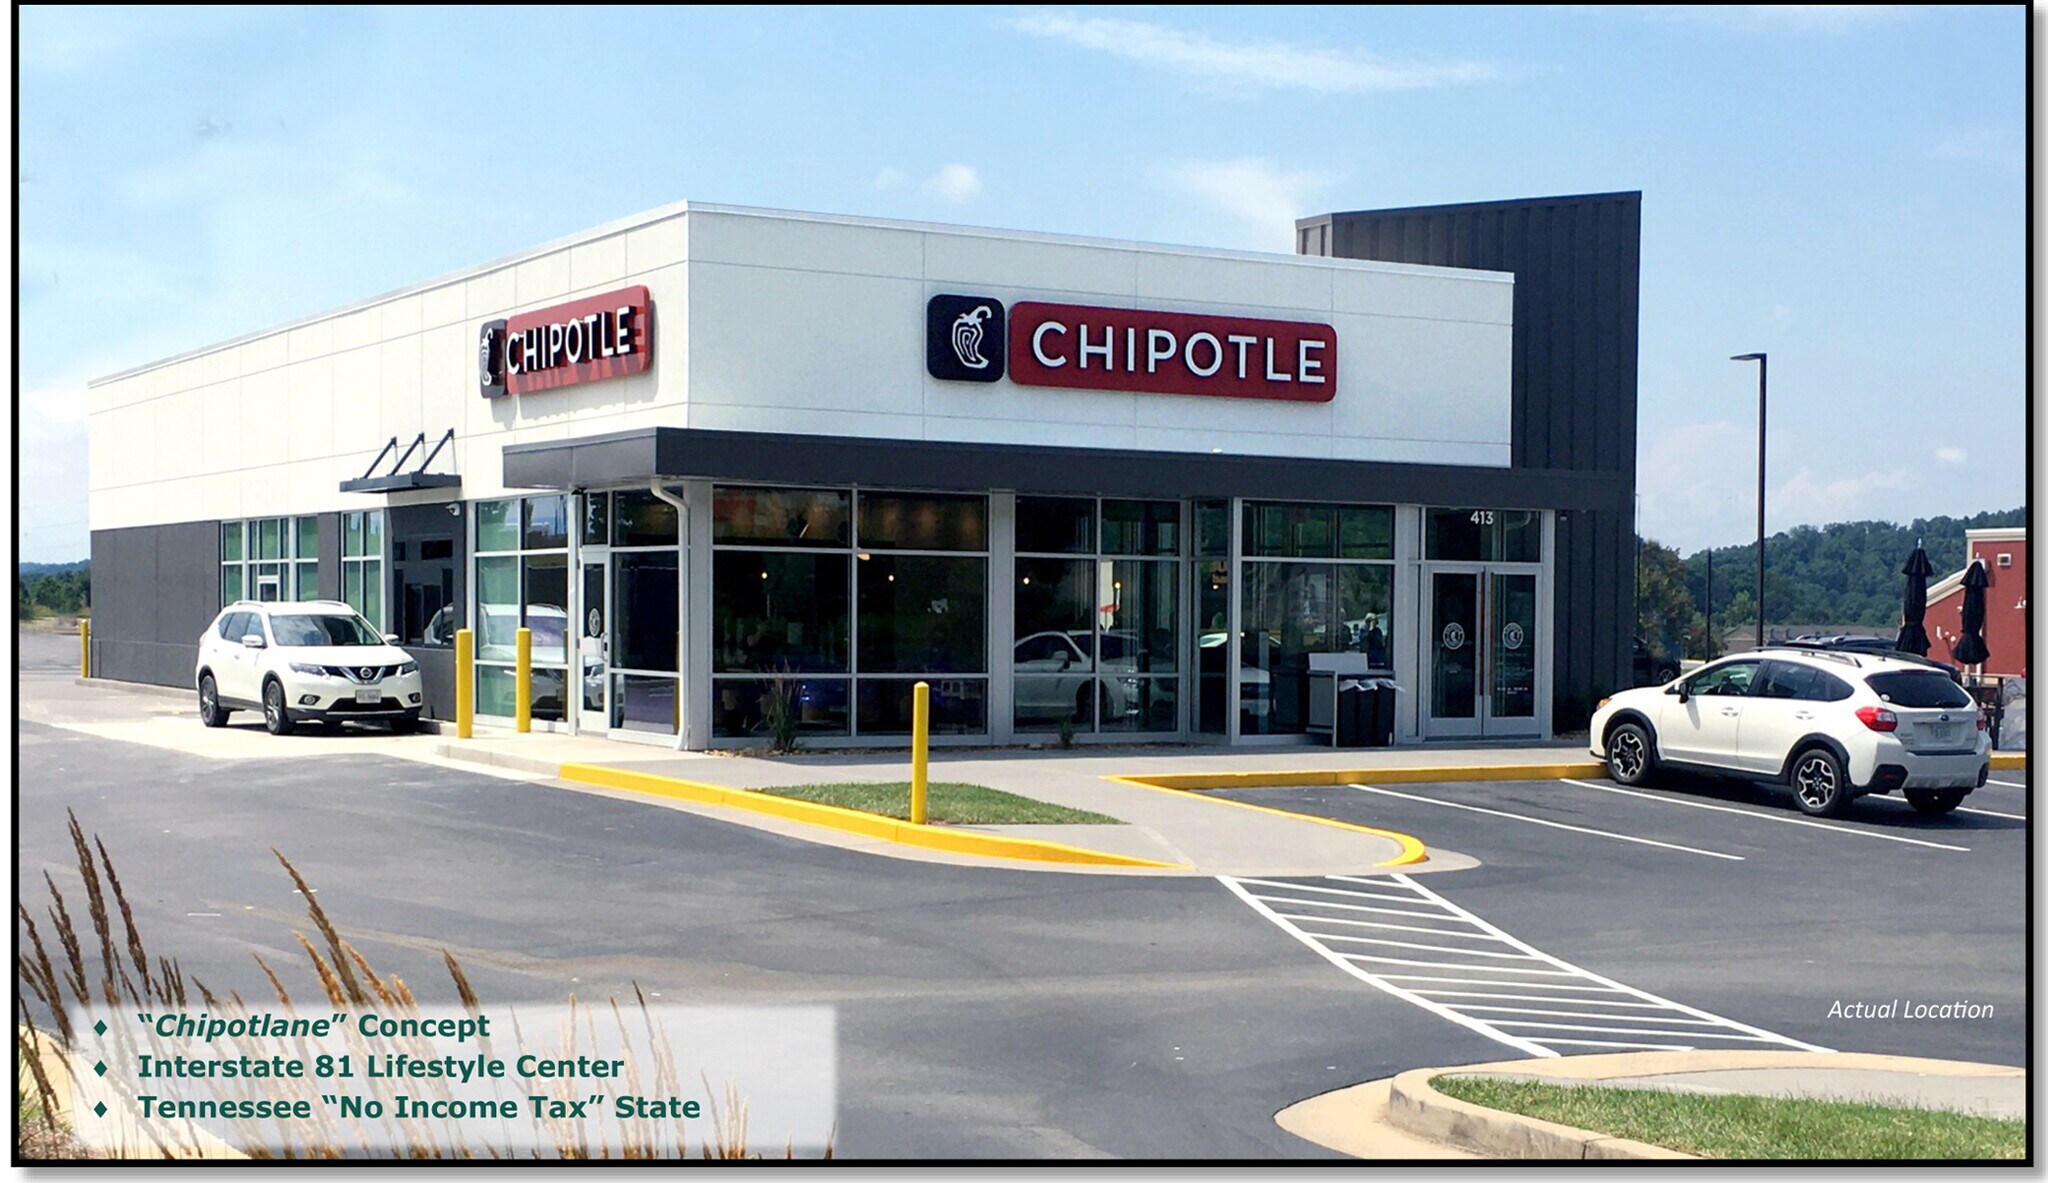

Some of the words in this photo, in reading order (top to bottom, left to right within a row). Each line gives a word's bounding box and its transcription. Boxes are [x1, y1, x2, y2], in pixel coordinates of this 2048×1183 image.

[506, 305, 631, 375] CHIPOTLE
[1032, 321, 1326, 384] CHIPOTLE
[1470, 510, 1494, 525] 413
